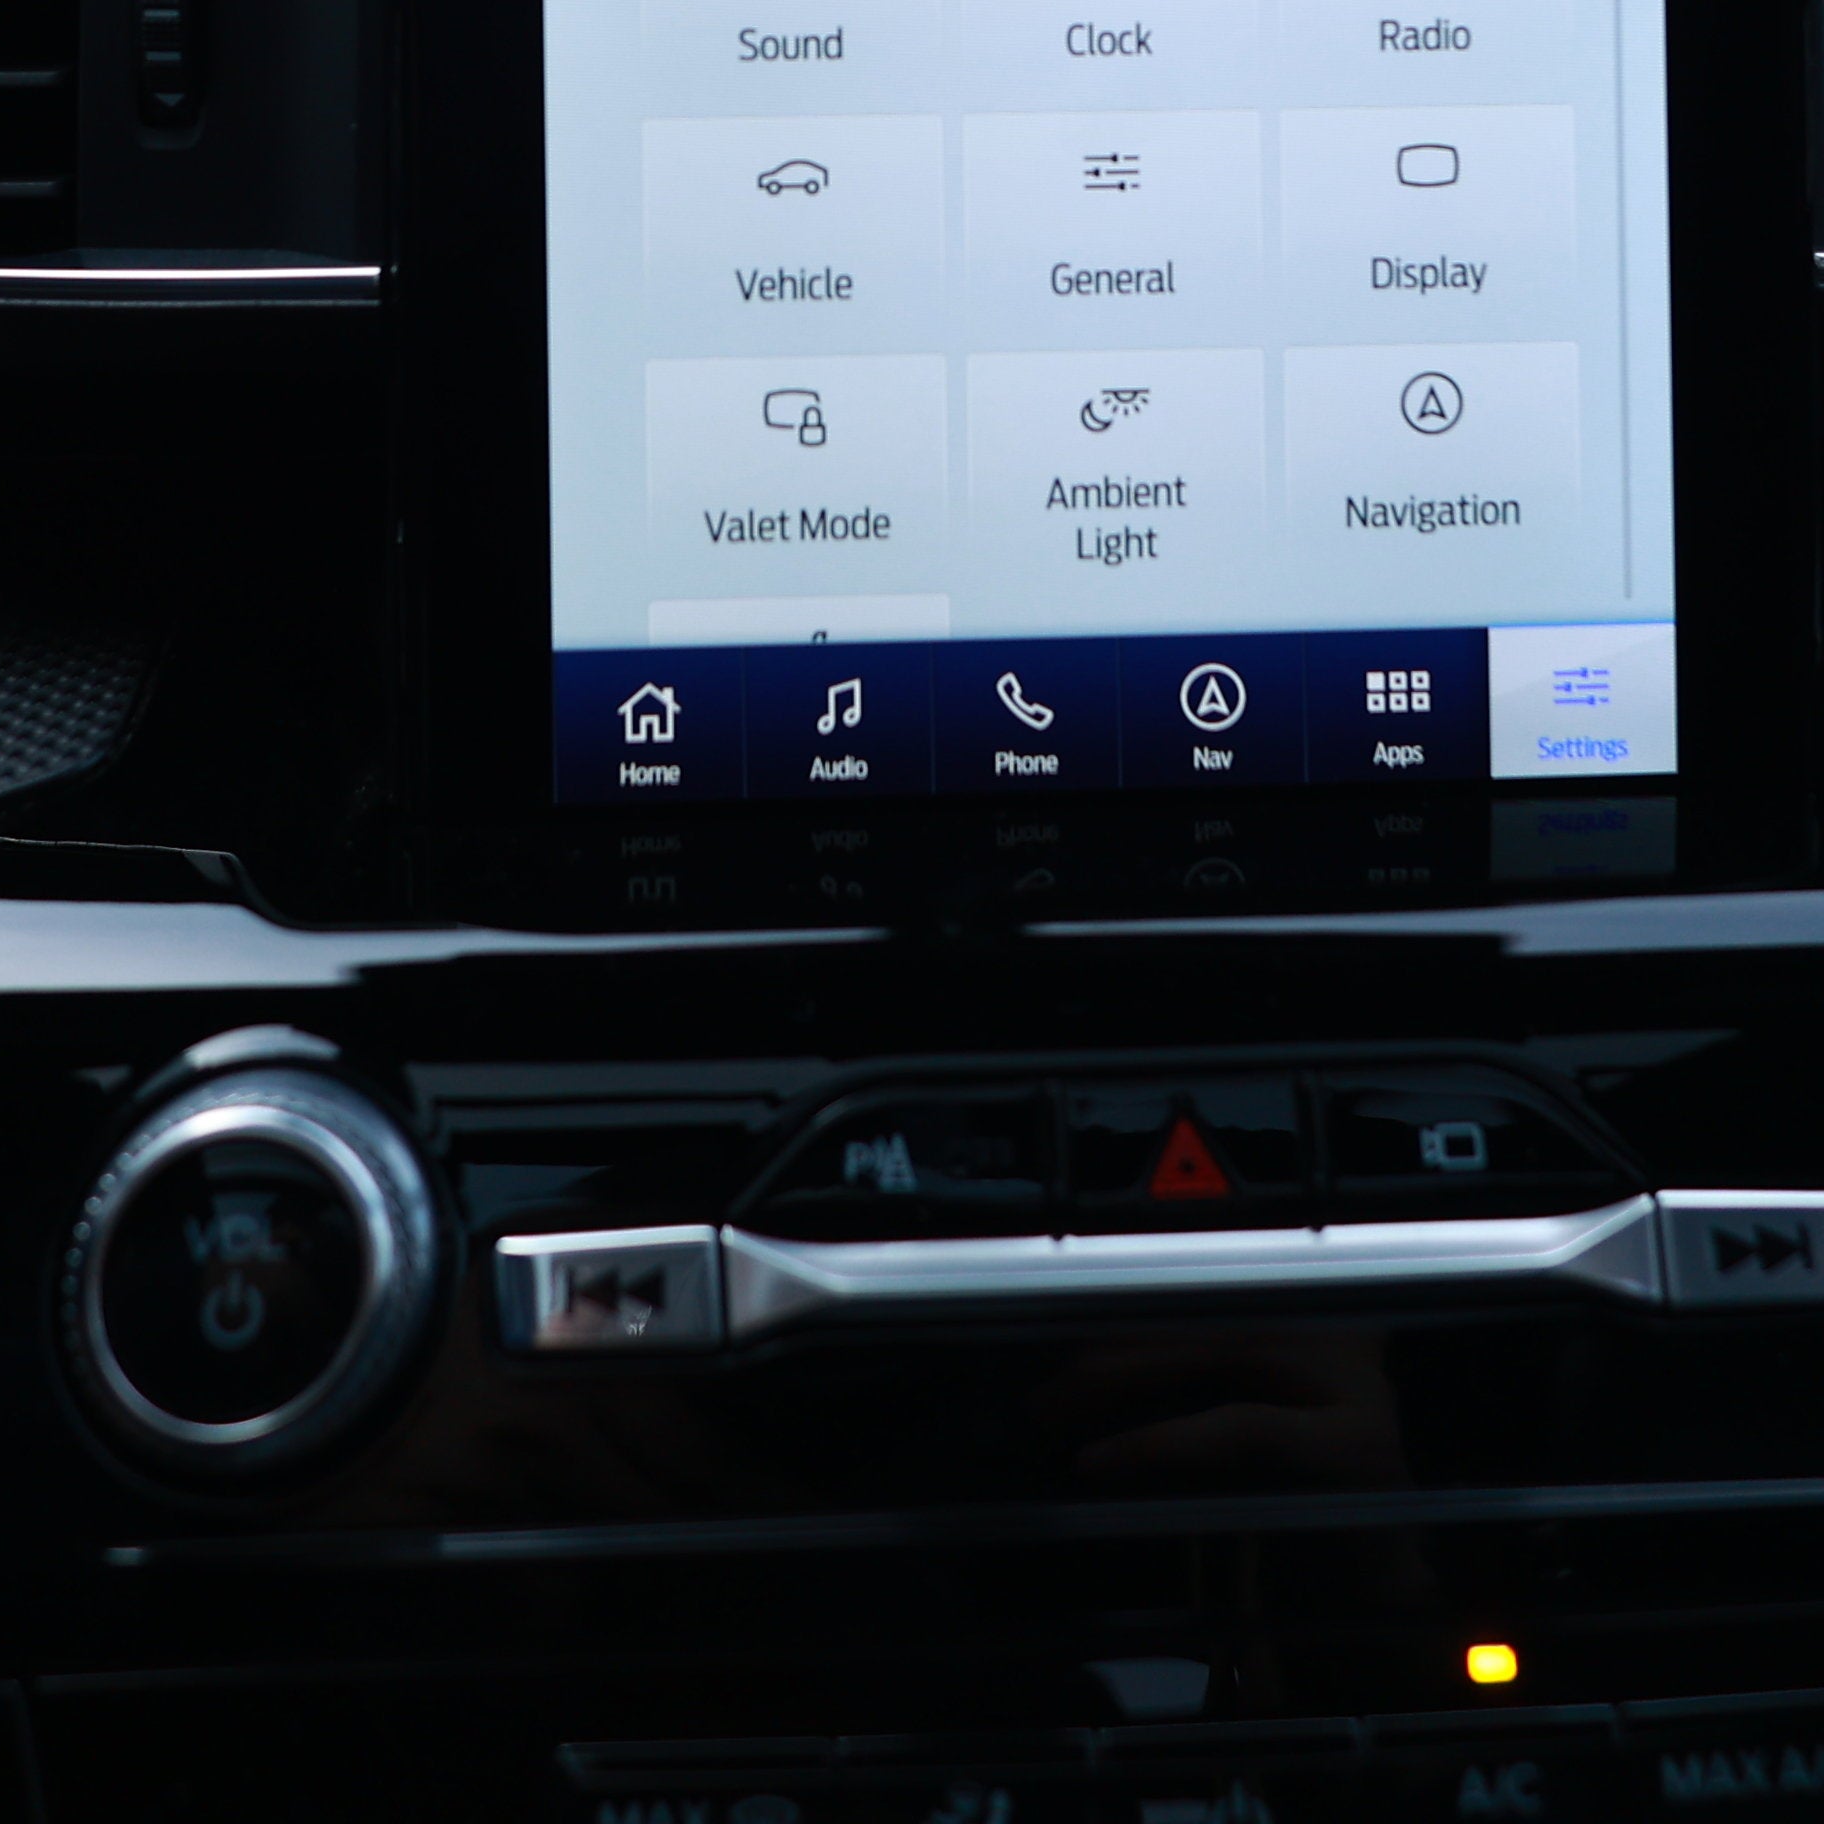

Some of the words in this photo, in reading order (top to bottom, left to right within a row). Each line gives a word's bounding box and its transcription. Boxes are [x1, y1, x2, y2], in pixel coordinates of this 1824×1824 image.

[739, 27, 843, 61] Sound
[1066, 23, 1152, 57] Clock
[1380, 19, 1471, 51] Radio
[736, 268, 852, 301] Vehicle
[1051, 261, 1174, 295] General
[1372, 256, 1487, 295] Display
[1046, 476, 1186, 509] Ambient
[705, 510, 789, 543] Valet
[800, 507, 890, 540] Mode
[1347, 496, 1520, 533] Navigation
[1077, 526, 1157, 565] Light
[995, 751, 1058, 774] Phone
[1194, 747, 1233, 769] Nav
[1373, 742, 1424, 767] Apps
[1538, 736, 1629, 762] Settings
[620, 763, 680, 785] Home
[810, 755, 868, 780] Audio
[1659, 1748, 1771, 1801] MAX
